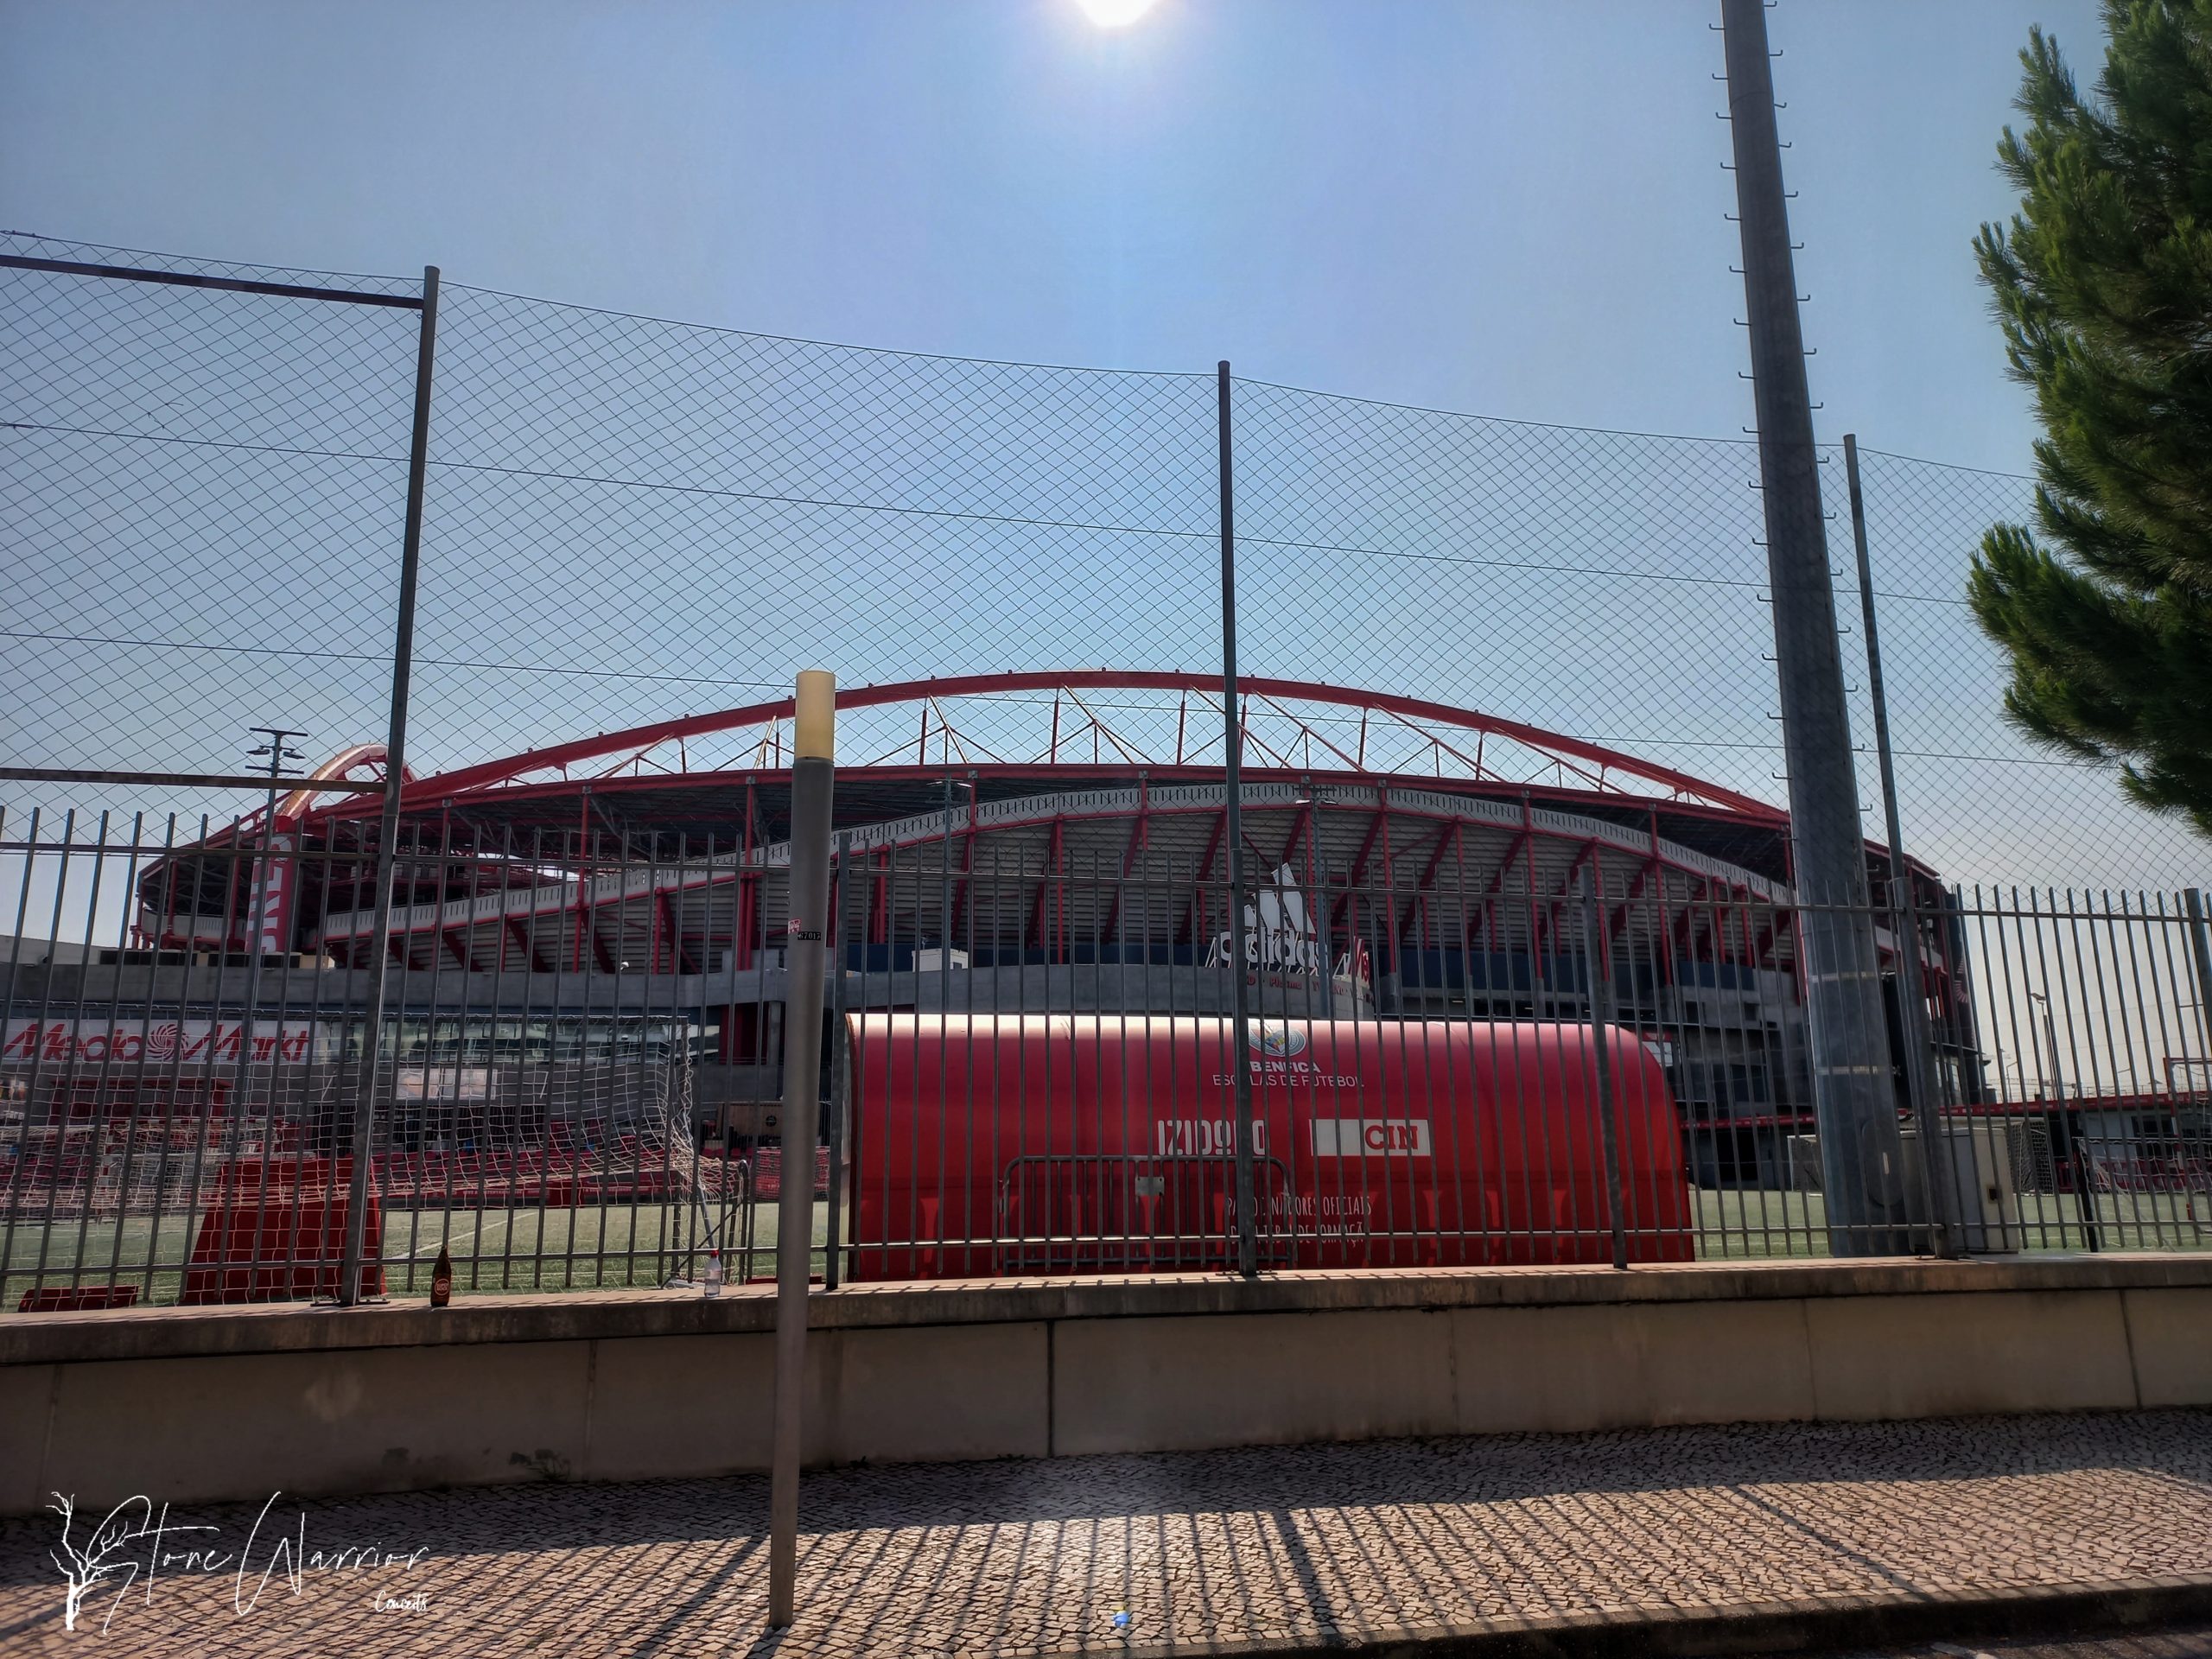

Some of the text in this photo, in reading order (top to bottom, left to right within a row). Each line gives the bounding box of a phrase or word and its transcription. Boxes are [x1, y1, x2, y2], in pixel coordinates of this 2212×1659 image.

[3, 1023, 144, 1062] Media
[1249, 1061, 1322, 1074] BENFICA
[1212, 1074, 1365, 1089] ESCLAS DE FUTEBOL
[1157, 1120, 1267, 1156] IZIDOO
[1364, 1125, 1420, 1151] CIN
